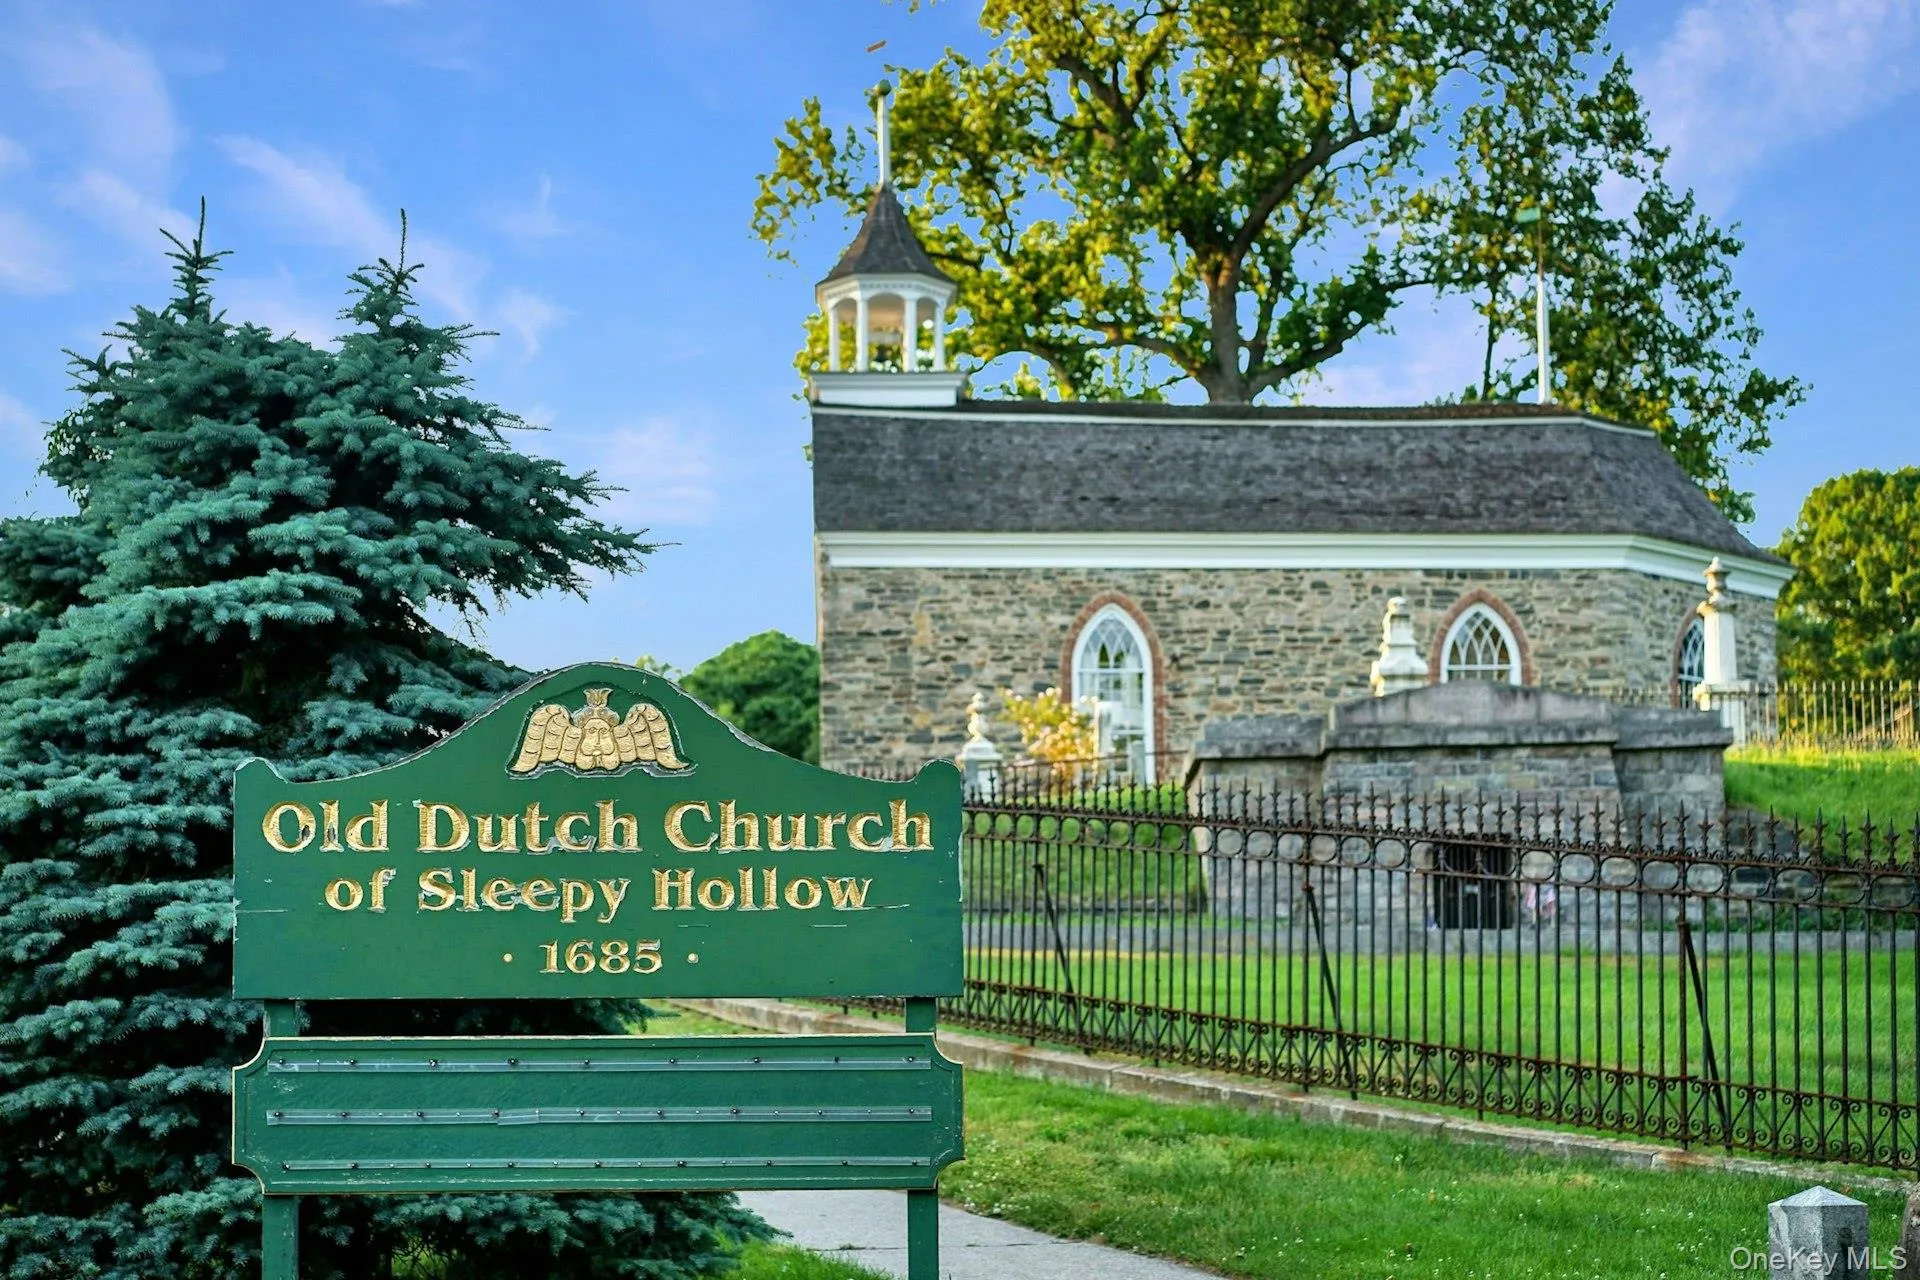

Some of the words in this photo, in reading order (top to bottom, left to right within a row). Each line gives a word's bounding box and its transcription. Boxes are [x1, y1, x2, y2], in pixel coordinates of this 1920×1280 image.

[262, 799, 390, 854] Old
[416, 799, 643, 854] Dutch
[664, 799, 934, 853] Church
[325, 867, 397, 913] of
[417, 866, 632, 924] Sleepy
[652, 865, 874, 912] Hollow
[539, 939, 664, 975] 1685
